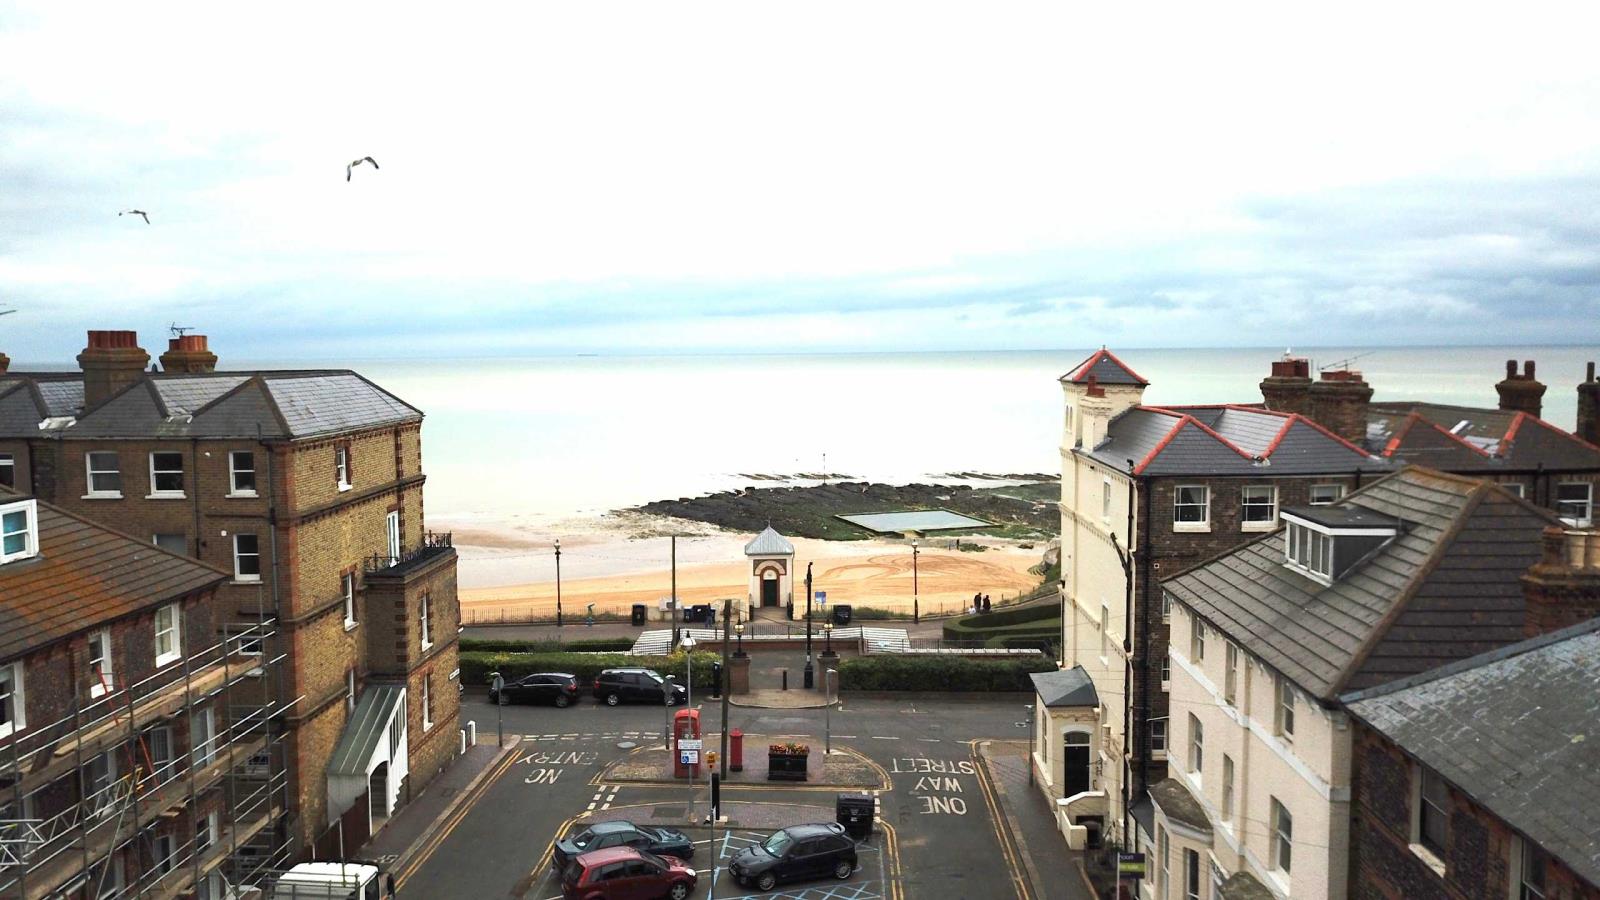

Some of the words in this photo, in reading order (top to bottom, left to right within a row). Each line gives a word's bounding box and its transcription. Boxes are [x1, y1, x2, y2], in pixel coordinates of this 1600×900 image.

[890, 758, 975, 775] STREET
[914, 776, 963, 793] WAY
[917, 796, 967, 815] ONE
